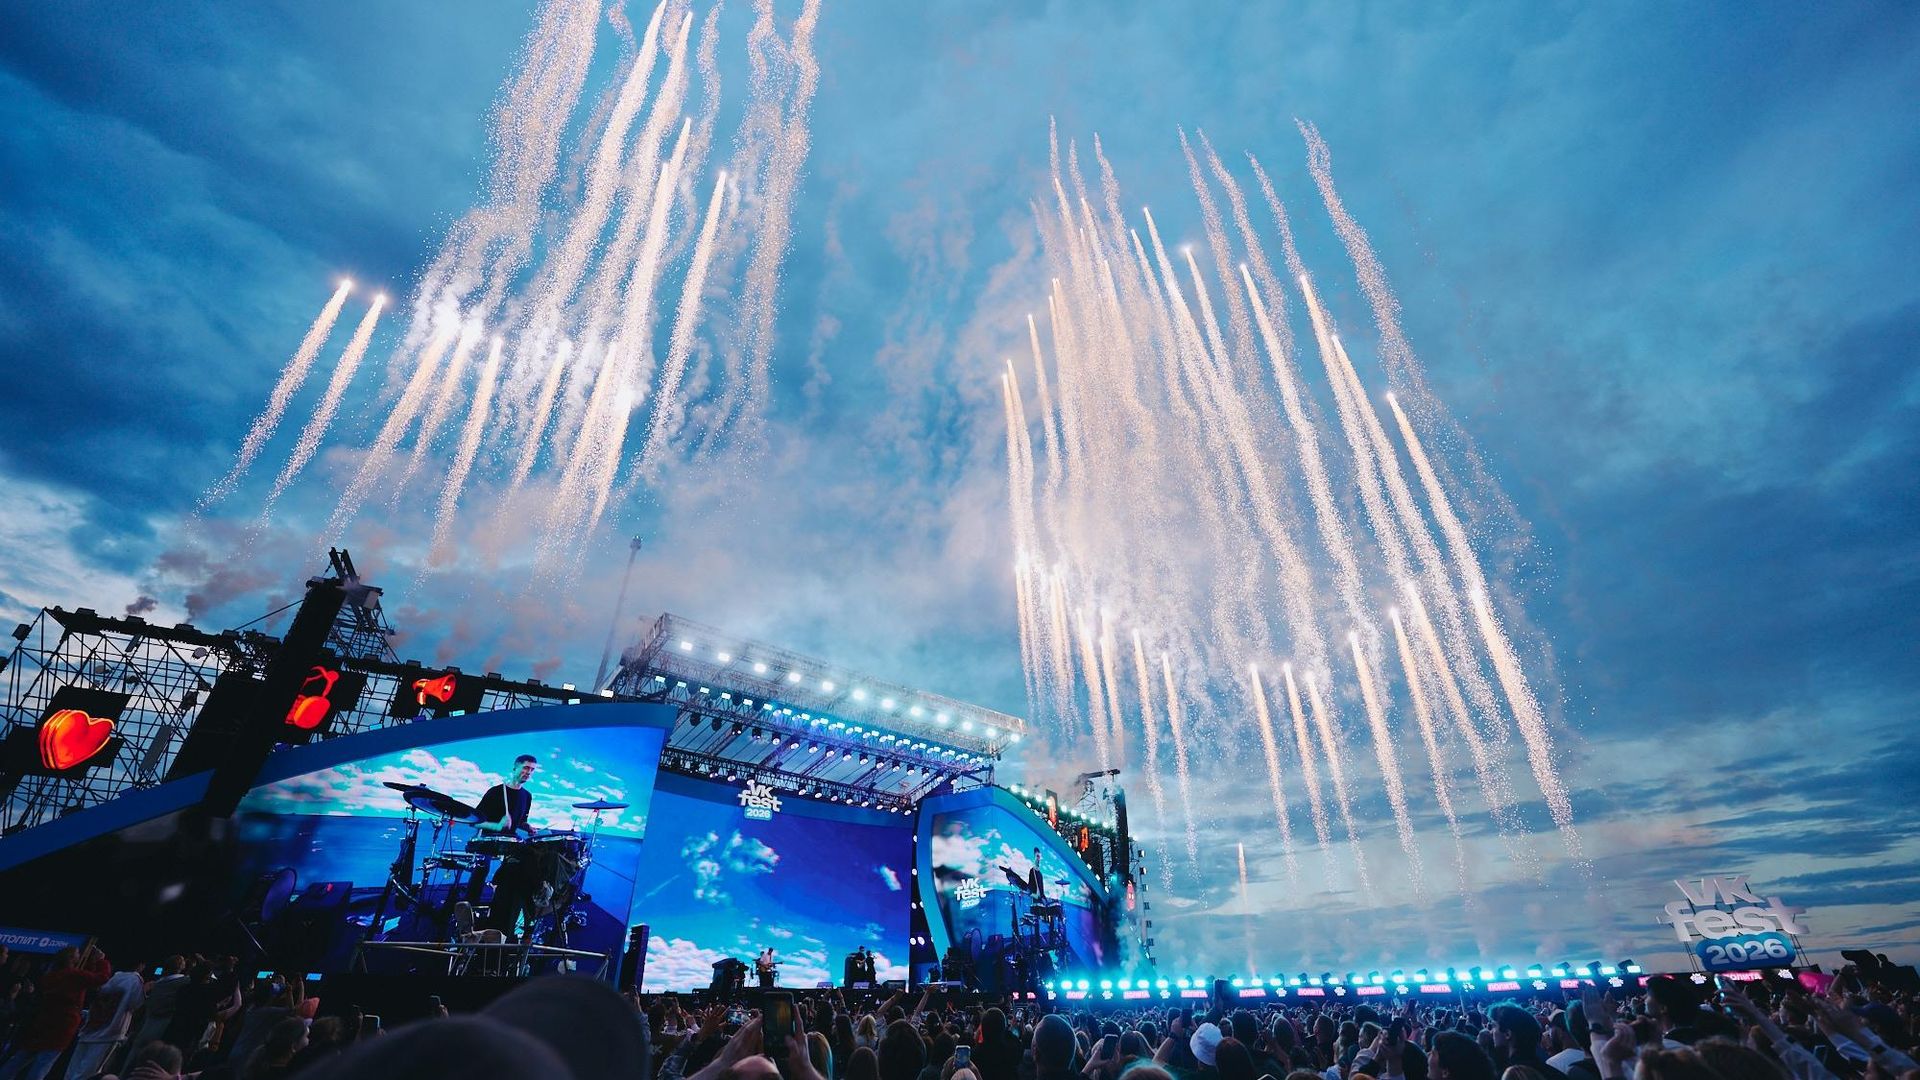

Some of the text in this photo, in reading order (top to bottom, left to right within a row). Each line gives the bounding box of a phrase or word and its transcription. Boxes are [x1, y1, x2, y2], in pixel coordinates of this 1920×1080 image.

[748, 783, 773, 798] VK
[738, 790, 783, 812] fest
[746, 808, 771, 818] 2026
[961, 878, 980, 889] VK
[1674, 875, 1765, 906] VK
[954, 884, 987, 901] fest
[1656, 897, 1810, 942] fest
[0, 934, 39, 945] ТОПИТ
[1706, 938, 1788, 965] 2026
